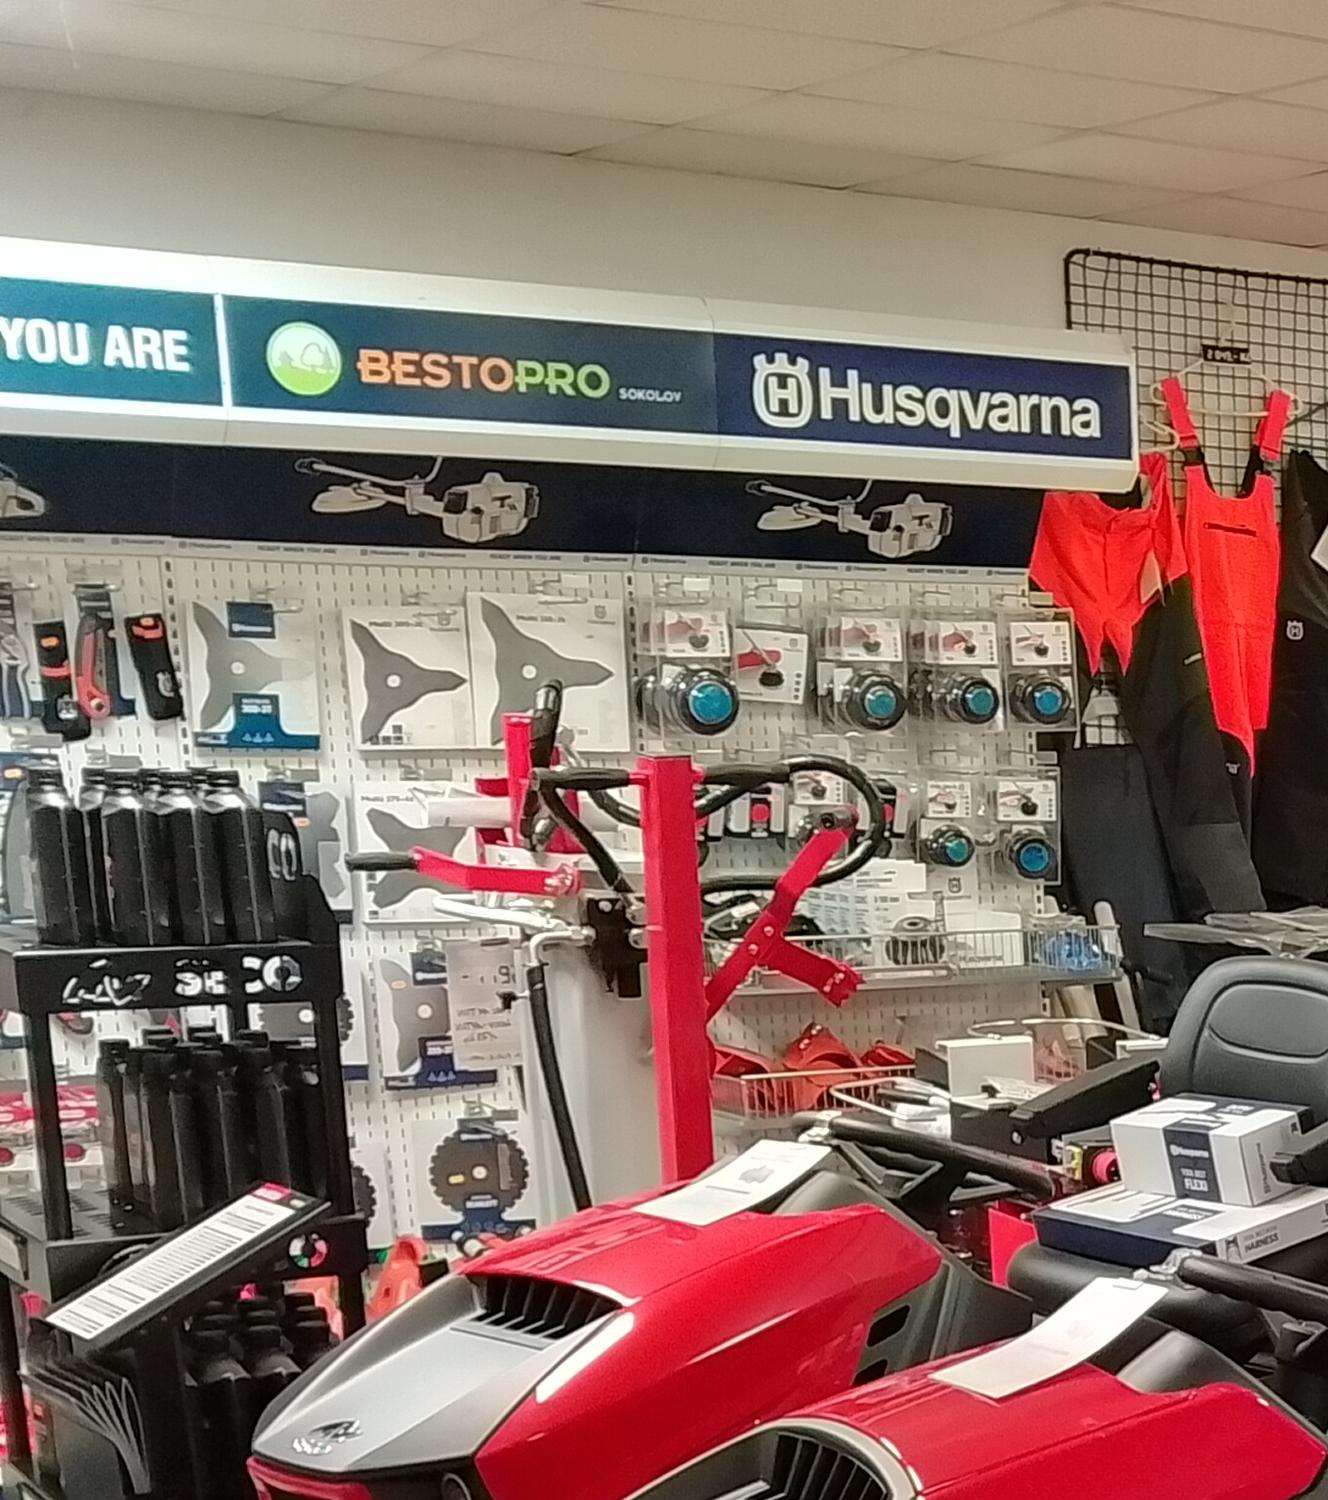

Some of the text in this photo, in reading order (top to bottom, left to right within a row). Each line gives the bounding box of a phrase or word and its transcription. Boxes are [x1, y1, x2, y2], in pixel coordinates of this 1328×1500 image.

[0, 317, 190, 372] YOU ARE
[618, 386, 682, 404] SOKOLOV
[818, 366, 1101, 438] Husqvarna
[1184, 1178, 1209, 1192] FLEXI
